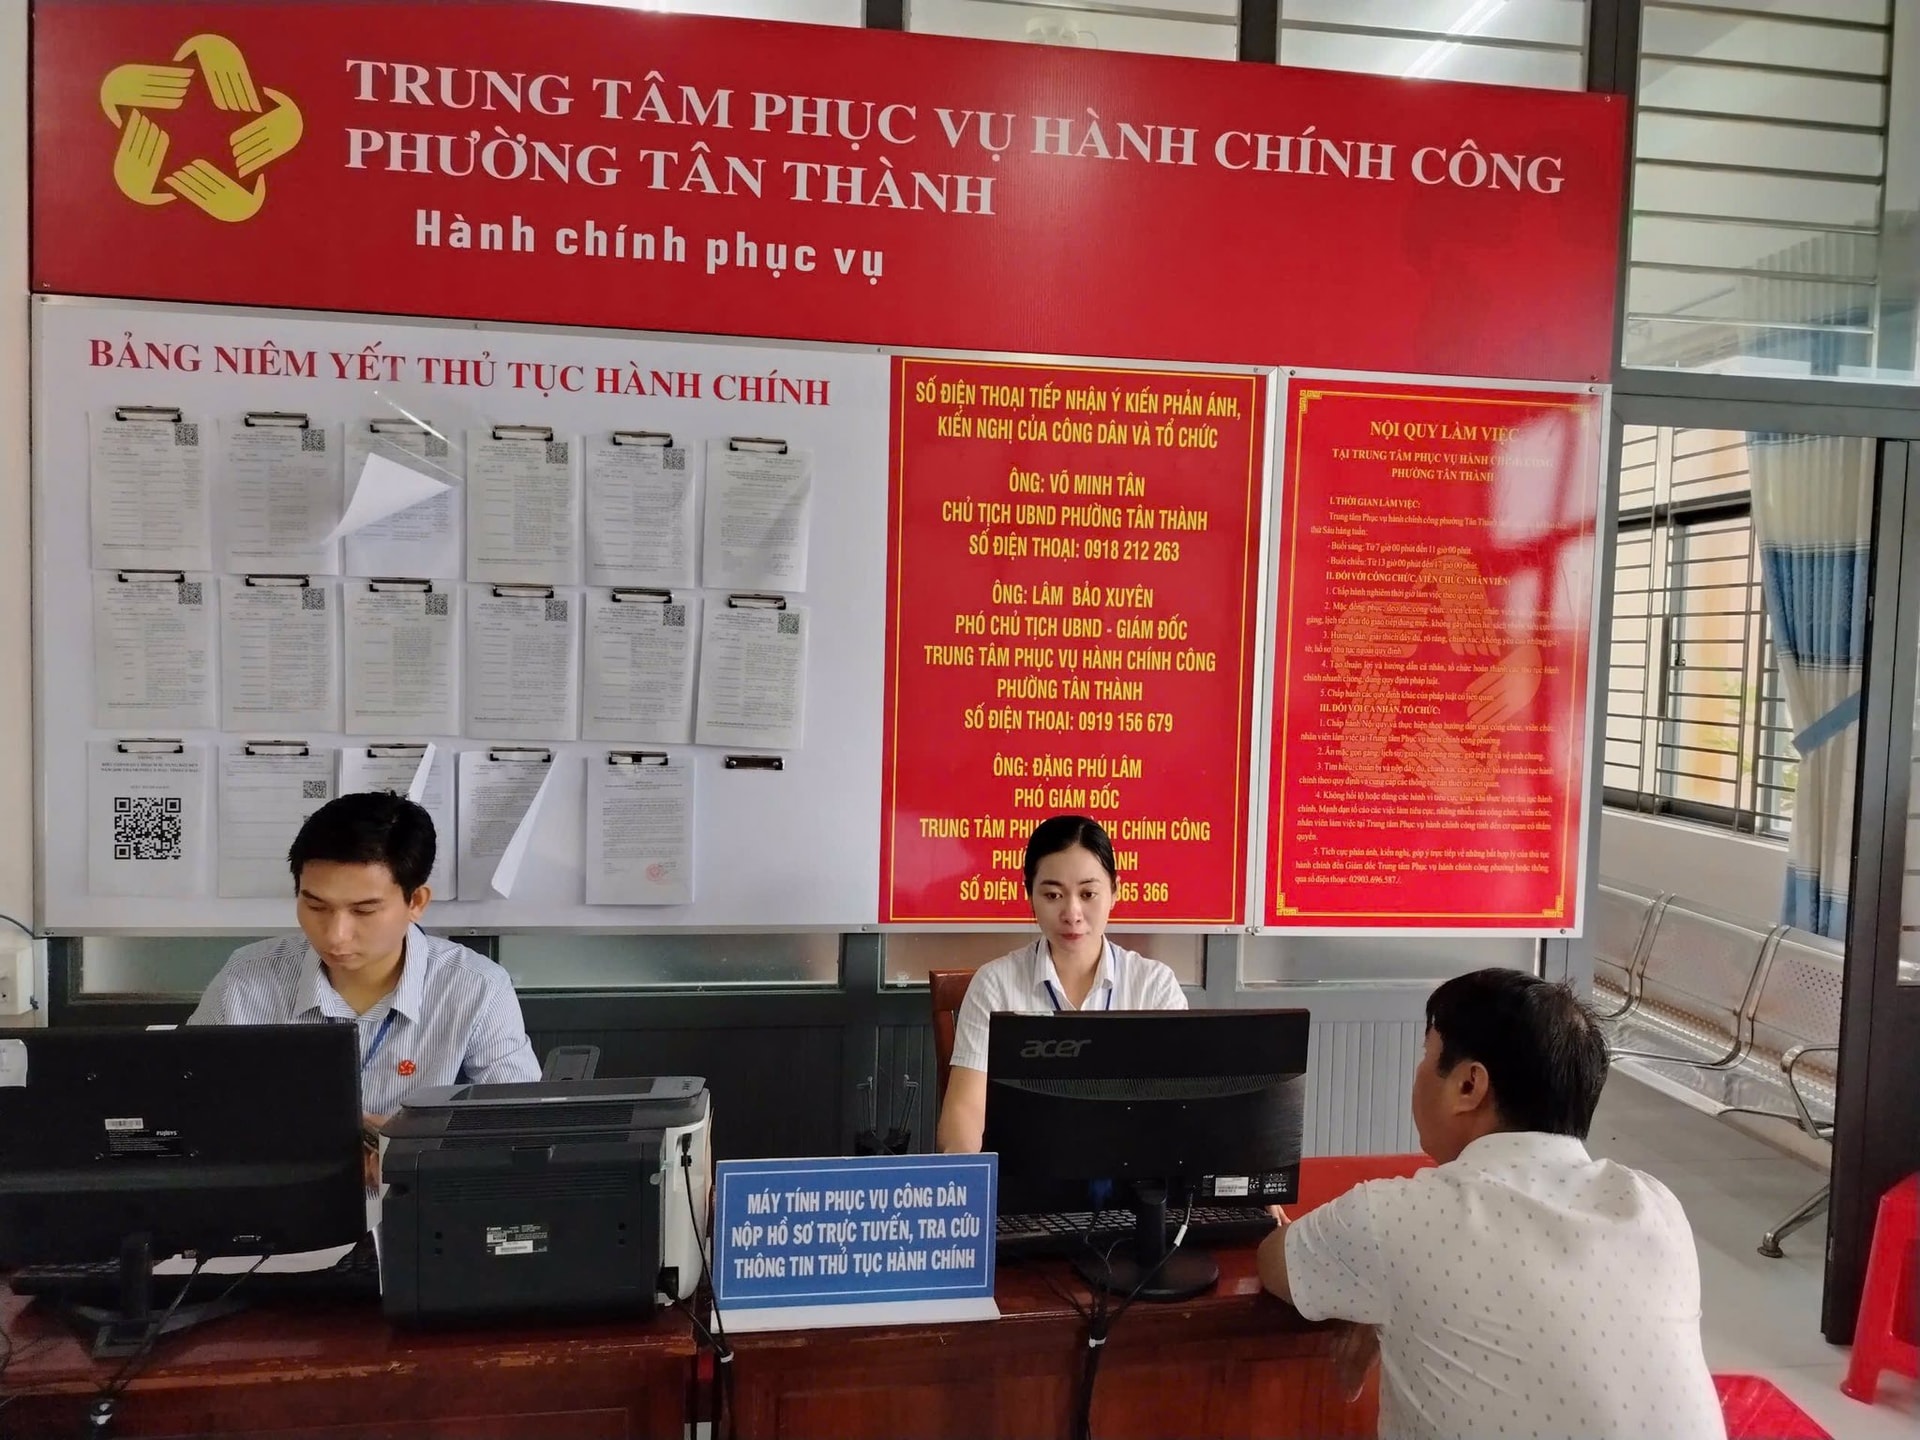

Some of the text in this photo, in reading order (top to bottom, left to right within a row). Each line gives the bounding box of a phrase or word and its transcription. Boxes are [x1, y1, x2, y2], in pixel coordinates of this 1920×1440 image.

[346, 59, 1565, 194] TRUNG TÂM PHỤC VỤ HÀNH CHÍNH CÔNG
[345, 126, 996, 215] PHƯỜNG TÂN THÀNH
[416, 209, 883, 285] Hành chính phục vụ
[90, 332, 830, 406] BẢNG NIÊM YẾT THỦ TỤC HÀNH CHÍNH
[916, 375, 1240, 420] SỐ ĐIỆN THOẠI TIẾP NHẬN Ý KIẾN PHẢN ÁNH,
[938, 409, 1218, 448] KIẾN NGHỊ CỦA CÔNG DÂN VÀ TỔ CHỨC
[1370, 420, 1400, 440] NỘI
[1403, 422, 1438, 441] QUY
[1441, 421, 1477, 440] LÀM
[1332, 448, 1350, 461] TẠI
[1351, 448, 1388, 462] TRUNG
[1389, 449, 1412, 463] TÂM
[1414, 452, 1442, 464] PHỤC
[1443, 453, 1458, 466] VỤ
[1009, 466, 1145, 497] ÔNG: VÕ MINH TÂN
[1392, 466, 1494, 481] PHƯỜNG TÂN THÀNH
[942, 496, 1208, 530] CHỦ TỊCH UBND PHƯỜNG TÂN THÀNH
[969, 528, 1179, 562] SỐ ĐIỆN THOẠI: 0918 212 263
[992, 579, 1153, 608] ÔNG: LÂM BẢO XUYÊN
[955, 610, 985, 635] PHÓ
[990, 610, 1020, 636] CHỦ
[1024, 616, 1057, 640] TỊCH
[1062, 618, 1102, 638] UBND
[1116, 615, 1153, 639] GIÁM
[1157, 613, 1188, 640] ĐỐC
[924, 642, 1216, 672] TRUNG TÂM PHỤC VỤ HÀNH CHÍNH CÔNG
[997, 674, 1142, 700] PHƯỜNG TÂN THÀNH
[964, 702, 1173, 734] SỐ ĐIỆN THOẠI: 0919 156 679
[993, 752, 1142, 781] ÔNG: ĐẶNG PHÚ LÂM
[1014, 782, 1120, 809] PHÓ GIÁM ĐỐC
[920, 818, 969, 838] TRUNG
[976, 814, 1005, 838] TÂM
[1122, 815, 1167, 840] CHÍNH
[1170, 817, 1211, 841] CÔNG
[960, 874, 980, 901] SỐ
[984, 876, 1018, 906] ĐIỆN
[1143, 882, 1169, 902] 366
[1020, 1039, 1091, 1057] acer
[748, 1181, 966, 1215] MÁY TÍNH PHỤC VỤ CÔNG DÂN
[732, 1212, 980, 1251] NỘP HỒ SƠ TRỰC TUYẾN, TRA CỨU
[734, 1244, 975, 1279] THÔNG TIN THỦ TỤC HÀNH CHÍNH
